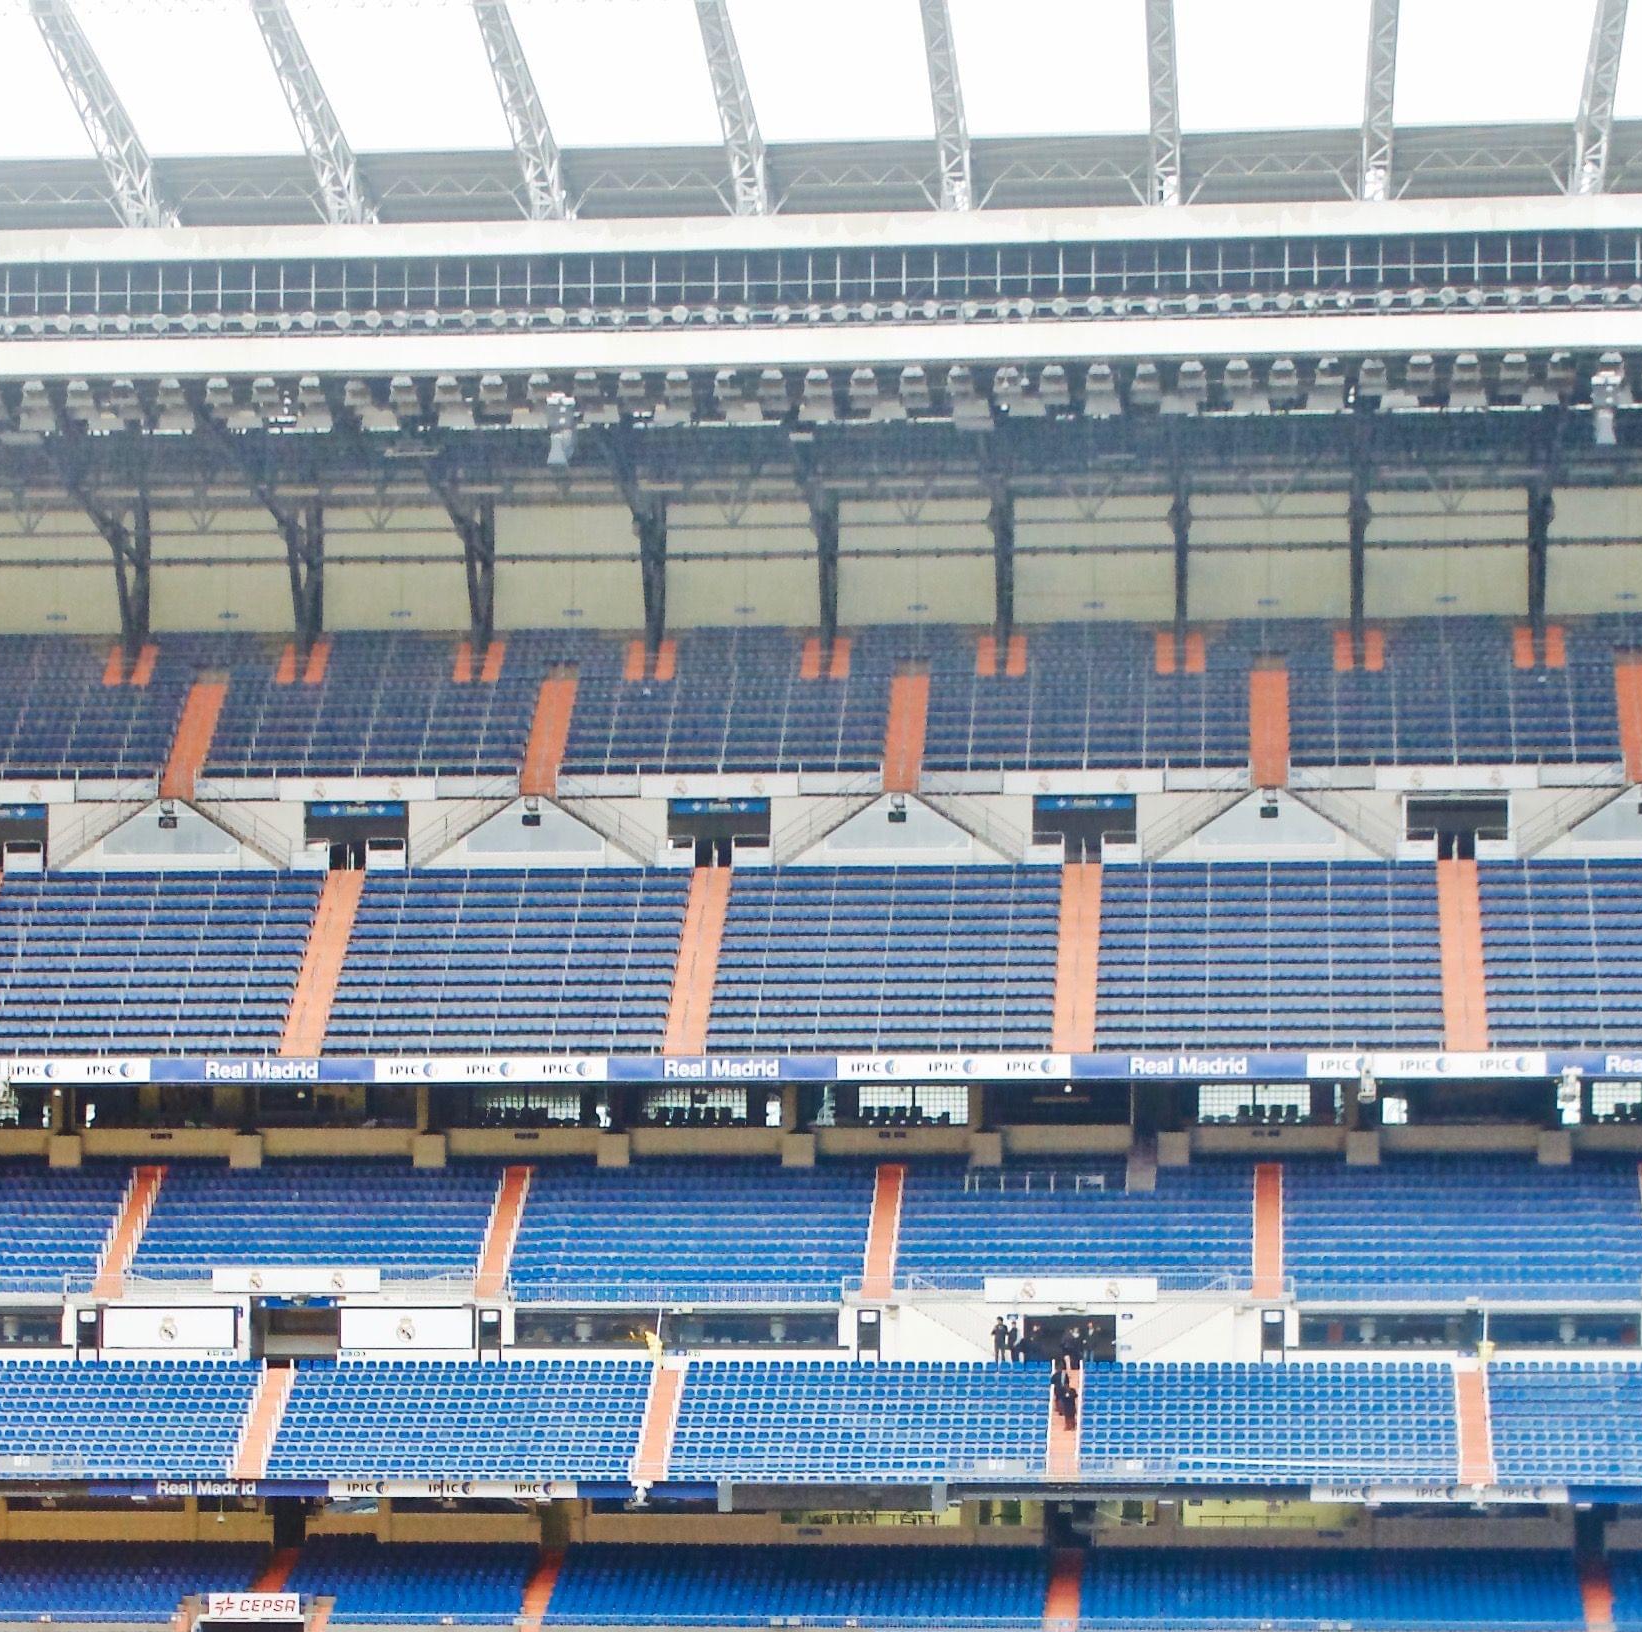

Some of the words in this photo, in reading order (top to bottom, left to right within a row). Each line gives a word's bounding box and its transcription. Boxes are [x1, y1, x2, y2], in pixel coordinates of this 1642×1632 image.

[87, 1065, 115, 1076] IPIC
[206, 1061, 247, 1079] Real
[253, 1061, 318, 1080] Madrid
[391, 1065, 419, 1076] IPIC
[467, 1064, 495, 1076] IPIC
[544, 1063, 572, 1075] IPIC
[665, 1059, 706, 1077] Real
[712, 1059, 778, 1077] Madrid
[852, 1062, 880, 1074] IPIC
[929, 1062, 957, 1072] IPIC
[1007, 1061, 1035, 1073] IPIC
[1131, 1057, 1173, 1075] Real
[1179, 1056, 1246, 1075] Madrid
[1321, 1059, 1349, 1071] IPIC
[1401, 1059, 1429, 1071] IPIC
[1480, 1059, 1510, 1070] IPIC
[157, 1480, 192, 1497] Real
[197, 1478, 256, 1498] Madrid
[240, 1598, 296, 1611] CEPSA
